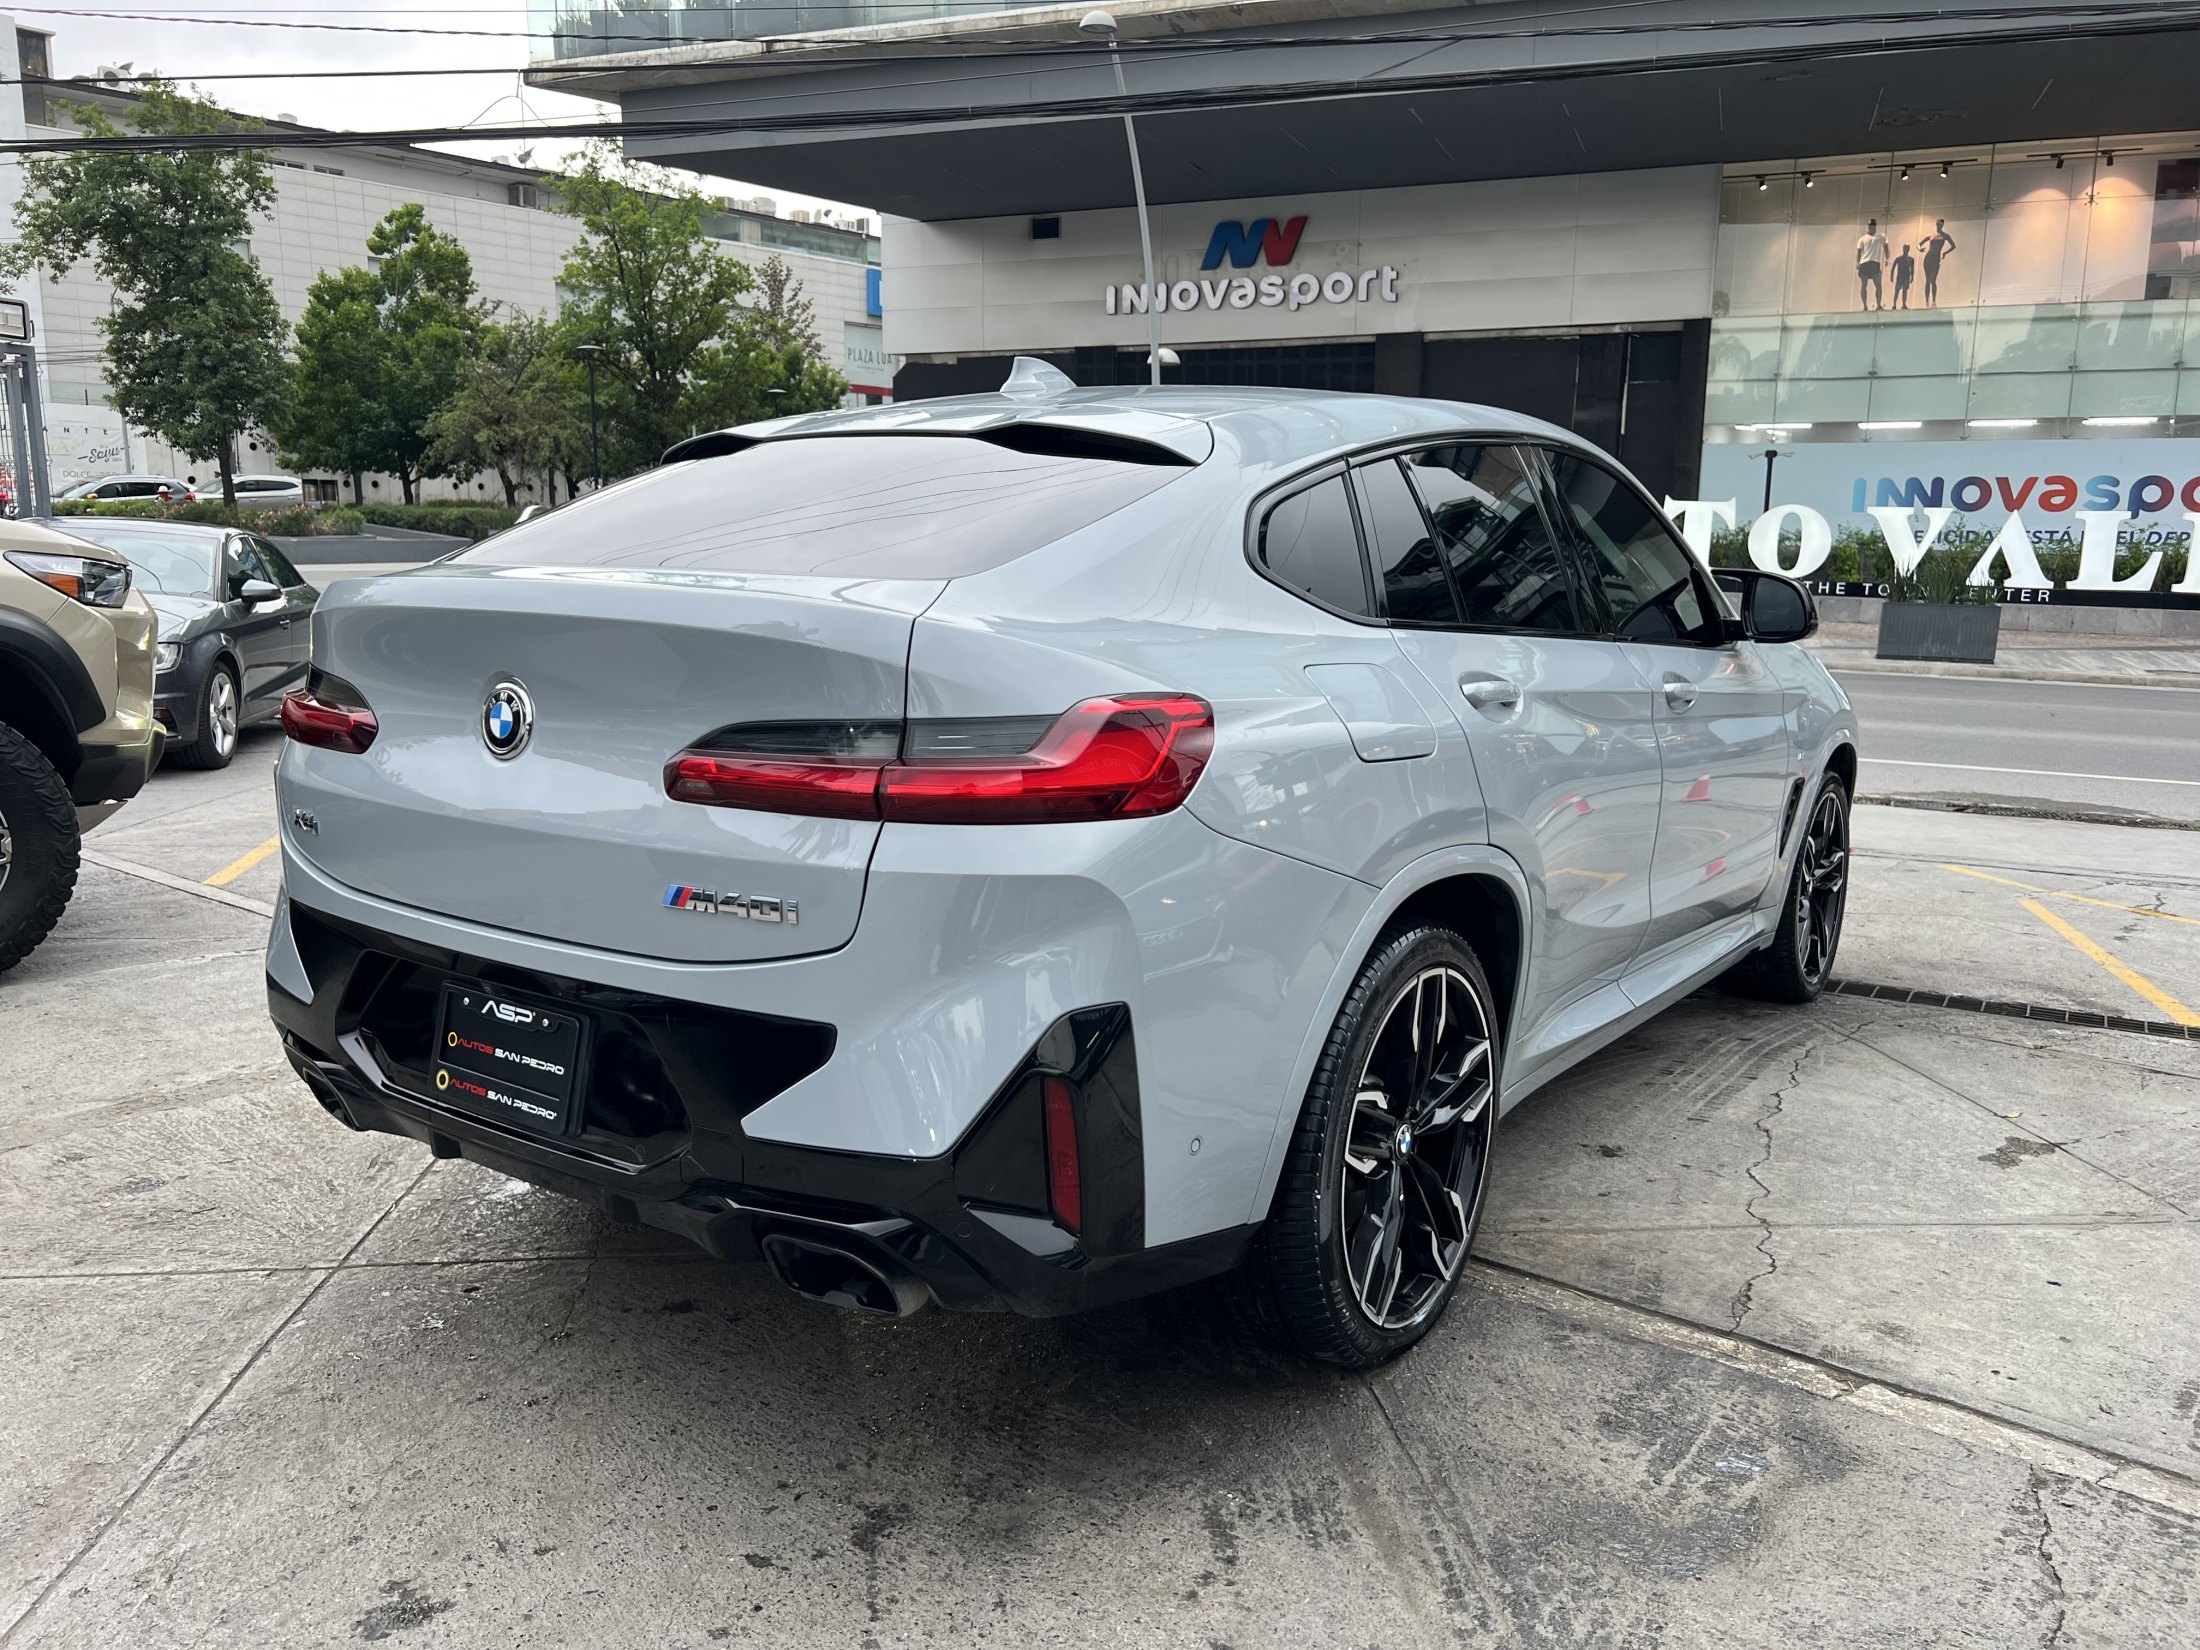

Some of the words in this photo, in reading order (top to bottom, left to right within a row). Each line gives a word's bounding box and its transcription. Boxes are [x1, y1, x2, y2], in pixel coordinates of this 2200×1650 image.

[848, 348, 874, 363] PLAZA
[2145, 530, 2191, 547] DEP
[1955, 586, 2050, 603] ENTER
[481, 1000, 536, 1023] ASP
[458, 1038, 494, 1055] AUTOS
[494, 1048, 521, 1063] SAN
[521, 1055, 565, 1075] PEDRO
[449, 1078, 487, 1097] AUTOS
[487, 1090, 513, 1106] SAN
[512, 1099, 557, 1120] PEDRO
